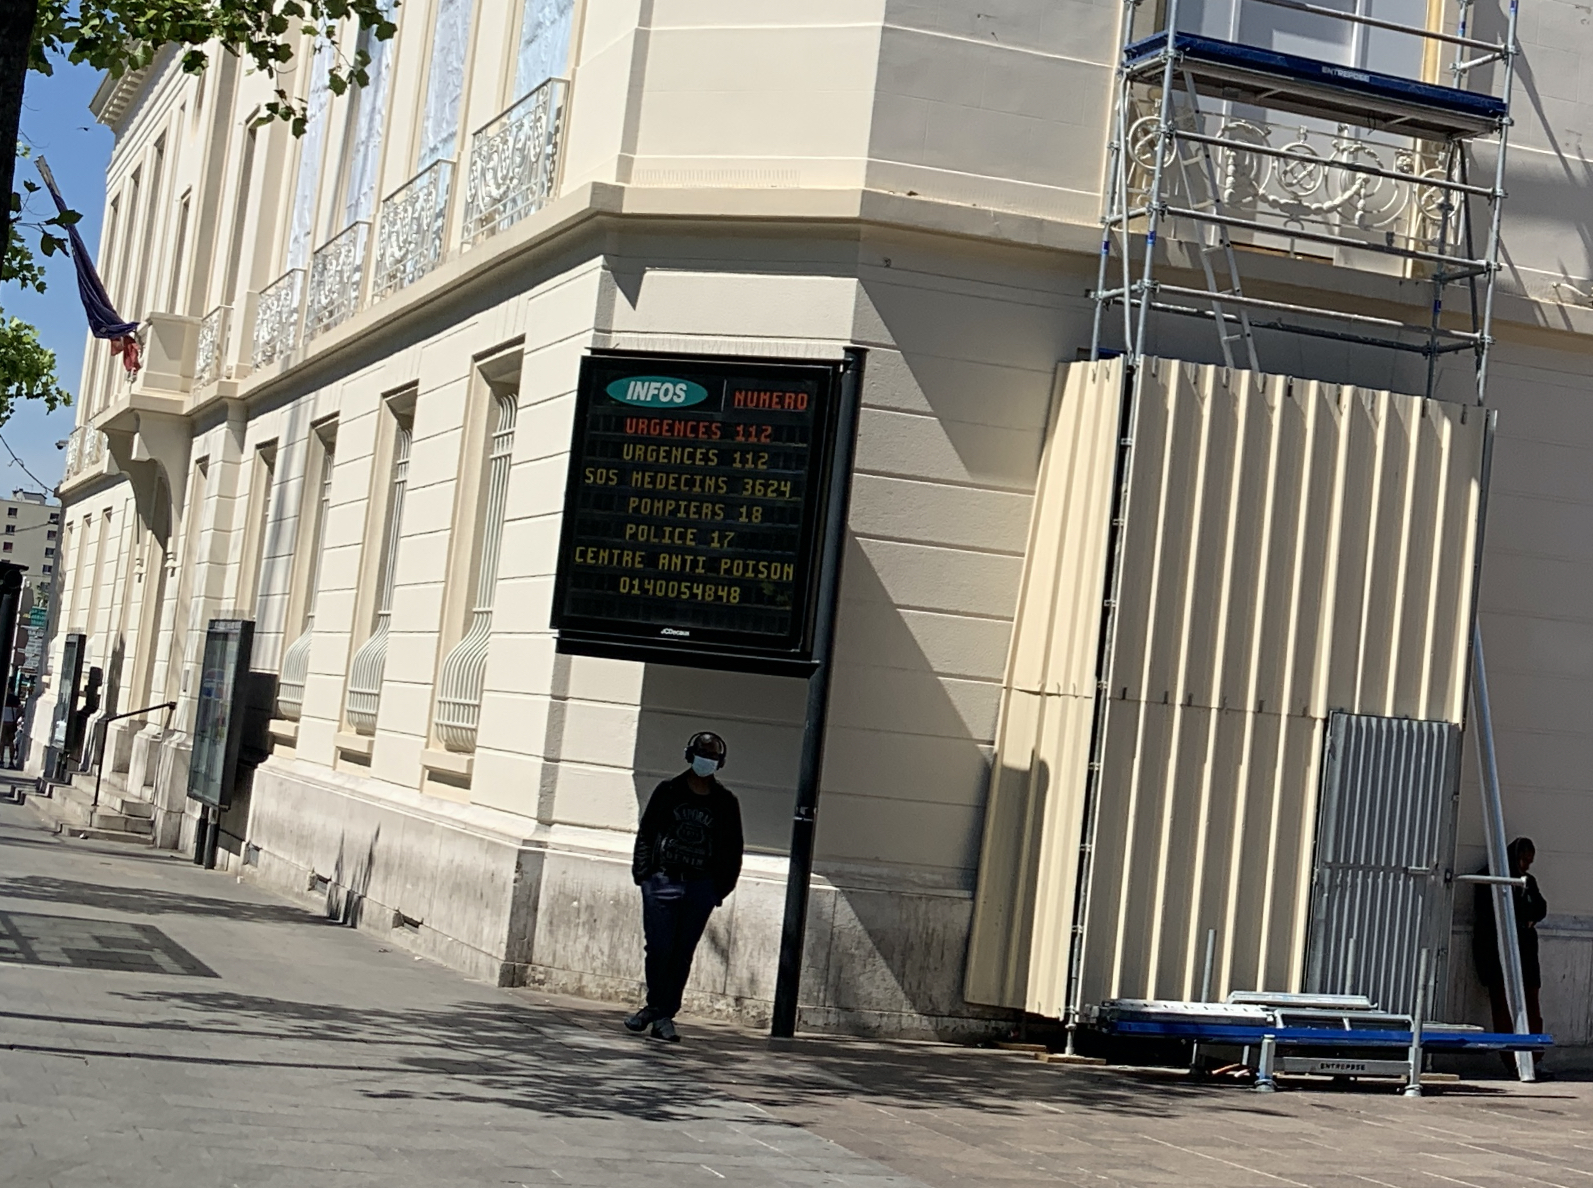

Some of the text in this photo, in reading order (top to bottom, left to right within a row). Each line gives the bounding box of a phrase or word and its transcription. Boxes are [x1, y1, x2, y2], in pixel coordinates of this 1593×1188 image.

[626, 381, 687, 403] INFOS
[734, 390, 808, 410] NUMERO
[626, 418, 772, 443] URGENCES 112
[623, 443, 769, 469] URGENCES 112
[585, 467, 791, 498] SOS MEDECINS 3624
[628, 497, 763, 523] POMPIERS 18
[625, 524, 735, 549] POLICE 17
[574, 546, 794, 581] CENTRE ANTI POISON
[619, 577, 741, 604] 0140054848
